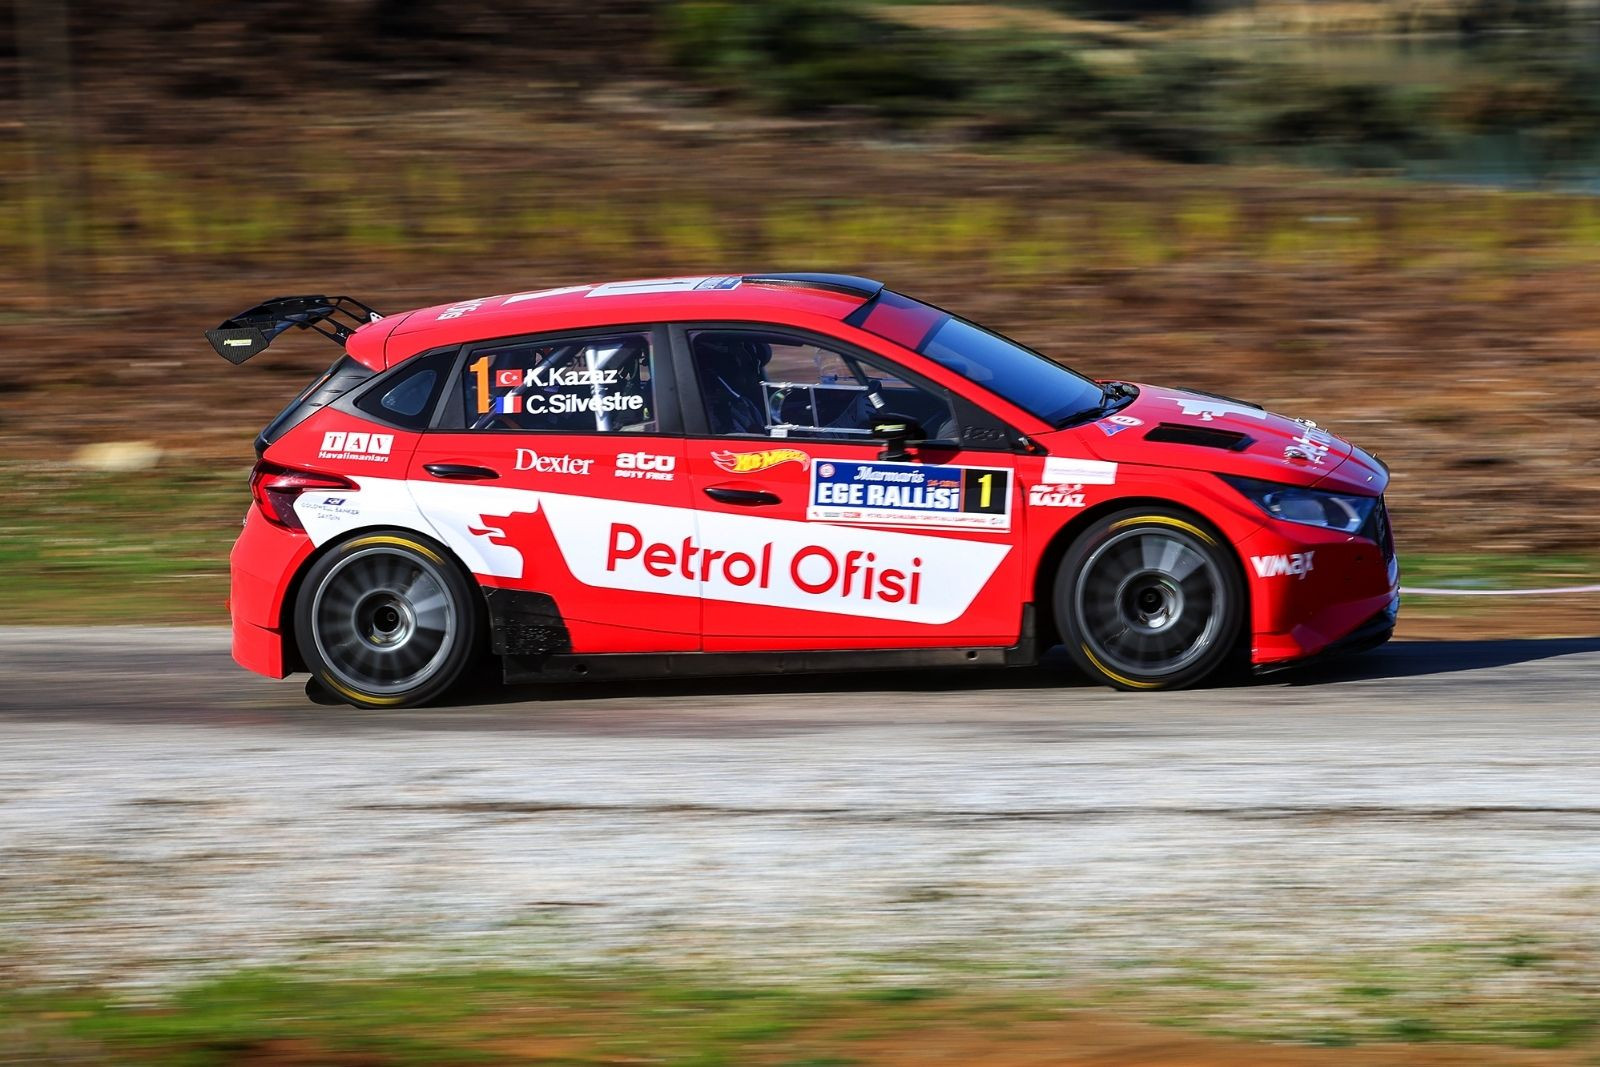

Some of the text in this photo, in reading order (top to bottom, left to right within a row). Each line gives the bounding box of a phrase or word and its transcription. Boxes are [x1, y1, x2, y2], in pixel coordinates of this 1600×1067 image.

[470, 357, 490, 413] 1
[524, 368, 617, 387] K.Kazaz
[526, 393, 643, 414] C.Silvestre
[324, 434, 391, 452] TAV
[515, 448, 594, 474] Dexter
[733, 453, 763, 472] HOT
[615, 469, 674, 481] DUTY FREE
[854, 466, 925, 483] Marmaris
[817, 482, 863, 505] EGE
[978, 474, 993, 508] 1
[1029, 493, 1087, 507] KAZAZ
[606, 522, 923, 605] Petrol Ofisi
